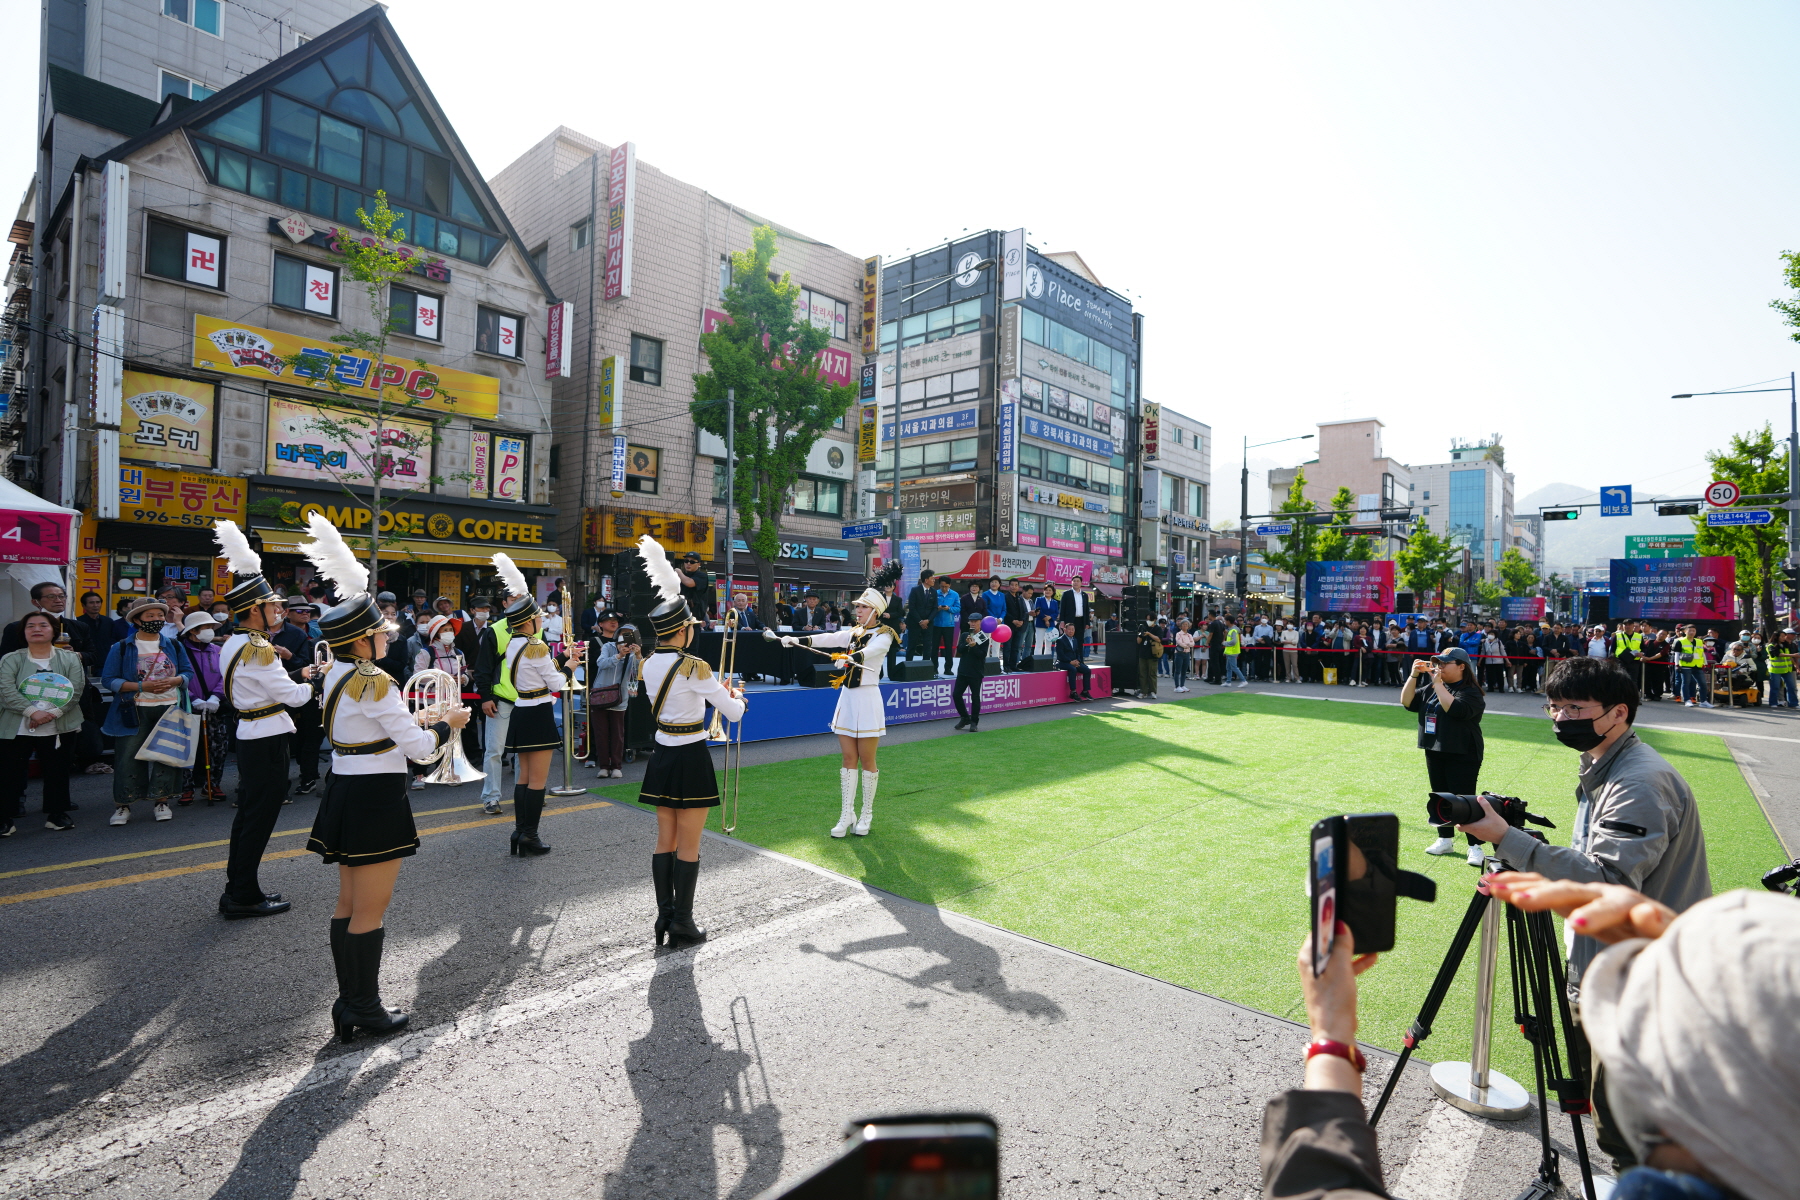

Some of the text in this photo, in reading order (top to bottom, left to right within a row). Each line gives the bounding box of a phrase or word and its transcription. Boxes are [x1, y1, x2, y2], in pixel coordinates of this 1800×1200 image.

[287, 218, 306, 229] 24시
[287, 226, 305, 237] 영업
[309, 279, 330, 301] 천
[607, 285, 620, 298] 3F
[1048, 281, 1082, 311] Place
[418, 306, 437, 327] 황
[811, 304, 834, 320] 보리사
[922, 355, 939, 364] 마사지
[863, 367, 874, 378] GS
[863, 376, 873, 388] 25
[443, 395, 458, 405] 2F
[961, 413, 969, 421] 3F
[1145, 405, 1159, 417] OK
[135, 419, 200, 450] 포커
[473, 433, 488, 444] 24시
[1002, 406, 1013, 465] 강북서울치과의원
[1043, 424, 1098, 452] 강북서울치과의원
[1145, 418, 1158, 453] 노래방
[275, 443, 348, 470] 바둑이
[499, 454, 519, 497] PC
[119, 468, 143, 504] 대원
[1000, 481, 1013, 490] 명가
[144, 478, 242, 514] 부동산
[900, 490, 950, 508] 명가한의원
[1058, 492, 1084, 511] 한의원
[1712, 488, 1733, 500] 50
[1000, 492, 1012, 538] 한의원
[1602, 504, 1630, 515] 비보호
[1709, 512, 1751, 521] 한천로144길
[133, 509, 227, 527] 996-557
[938, 514, 954, 528] 통증
[956, 512, 973, 526] 비만
[458, 517, 543, 544] COFFEE
[638, 516, 710, 543] 노래방
[1053, 522, 1080, 537] 교통사고
[1001, 557, 1032, 570] 삼천리자전거
[165, 565, 199, 580] 대원
[887, 678, 1021, 709] 4·19혁명문화제
